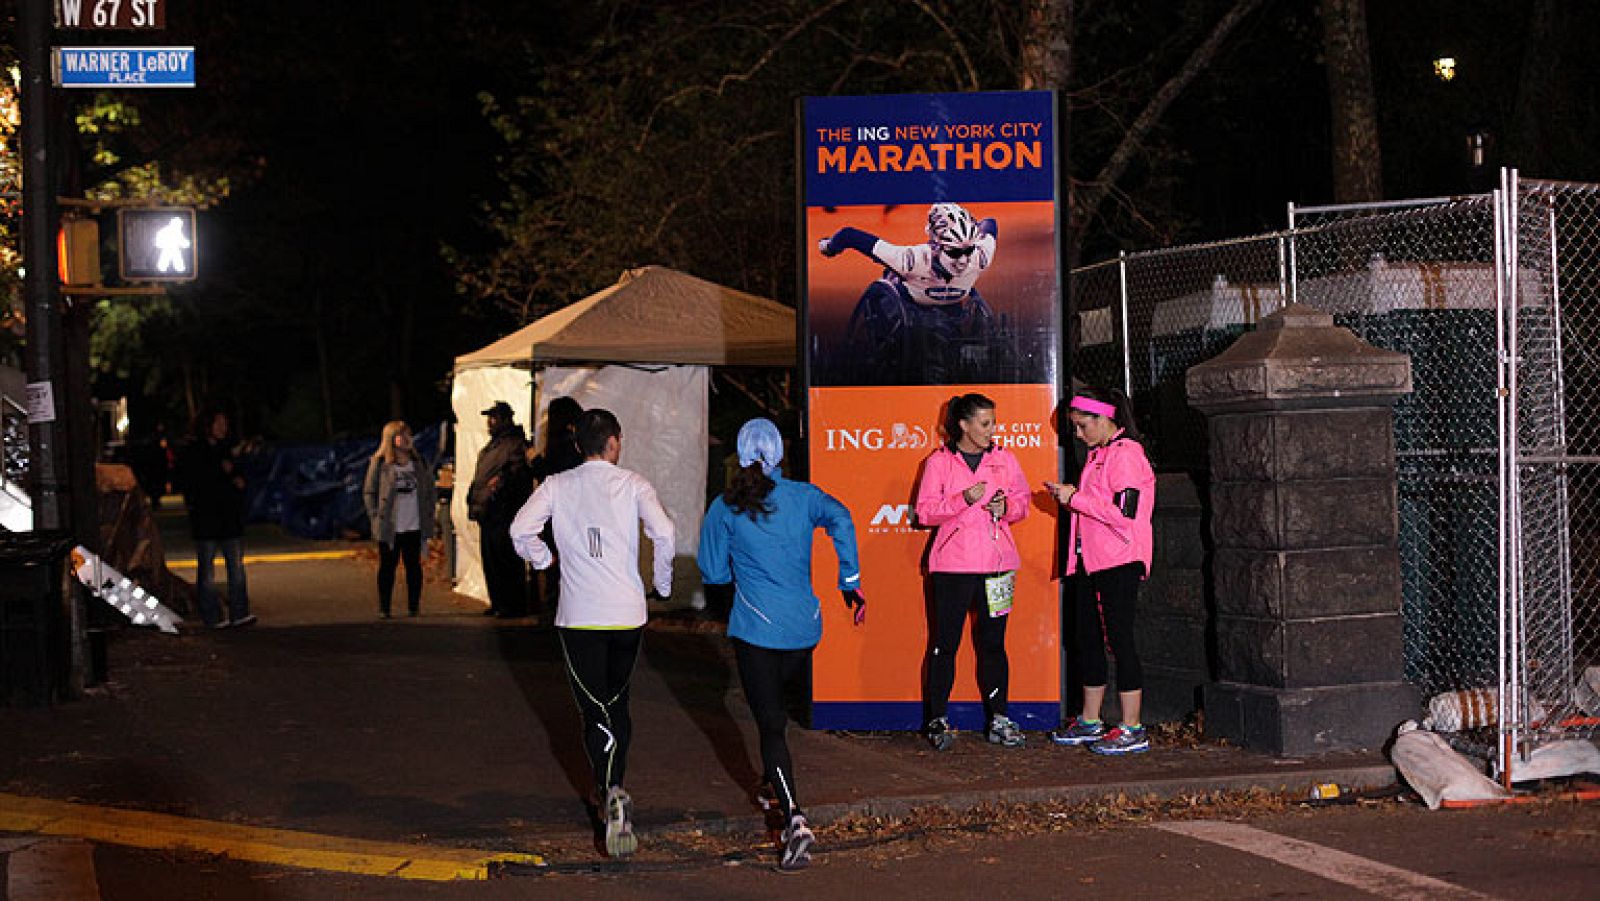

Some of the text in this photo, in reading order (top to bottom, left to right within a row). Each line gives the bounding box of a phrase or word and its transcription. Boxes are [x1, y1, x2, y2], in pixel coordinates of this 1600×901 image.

[62, 0, 157, 27] W 67 ST
[65, 51, 189, 72] WARNER LeROY
[108, 71, 147, 83] PLACE
[816, 122, 1043, 143] THE ING NEW YORK CITY
[816, 141, 1043, 174] MARATHON
[1011, 422, 1042, 433] CITY
[825, 428, 884, 451] ING
[991, 434, 1042, 448] THON
